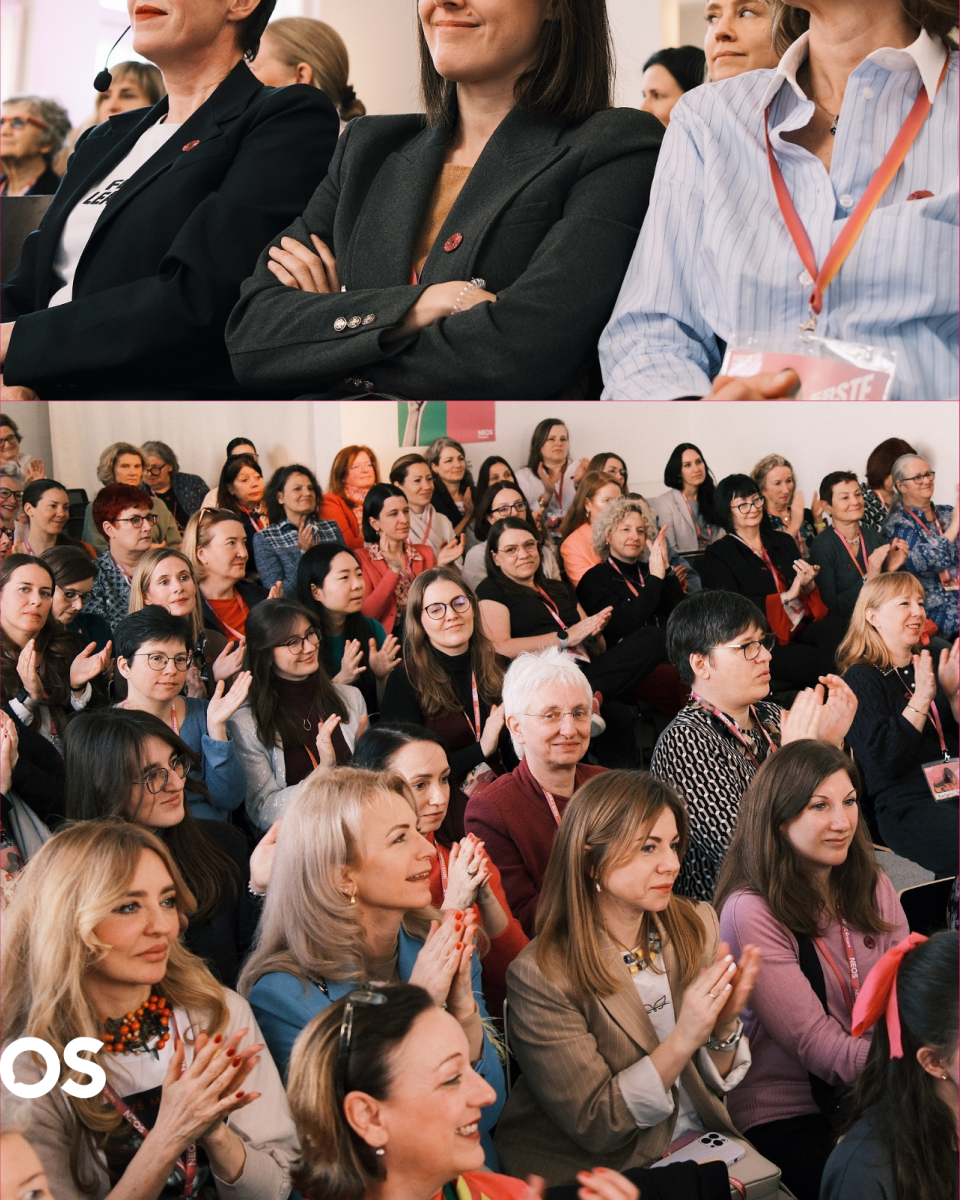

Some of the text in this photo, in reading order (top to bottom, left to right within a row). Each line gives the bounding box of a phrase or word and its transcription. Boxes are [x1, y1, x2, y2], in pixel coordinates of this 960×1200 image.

[849, 957, 859, 979] NEOS
[123, 1109, 146, 1134] NEOS
[187, 1141, 197, 1167] NEO
